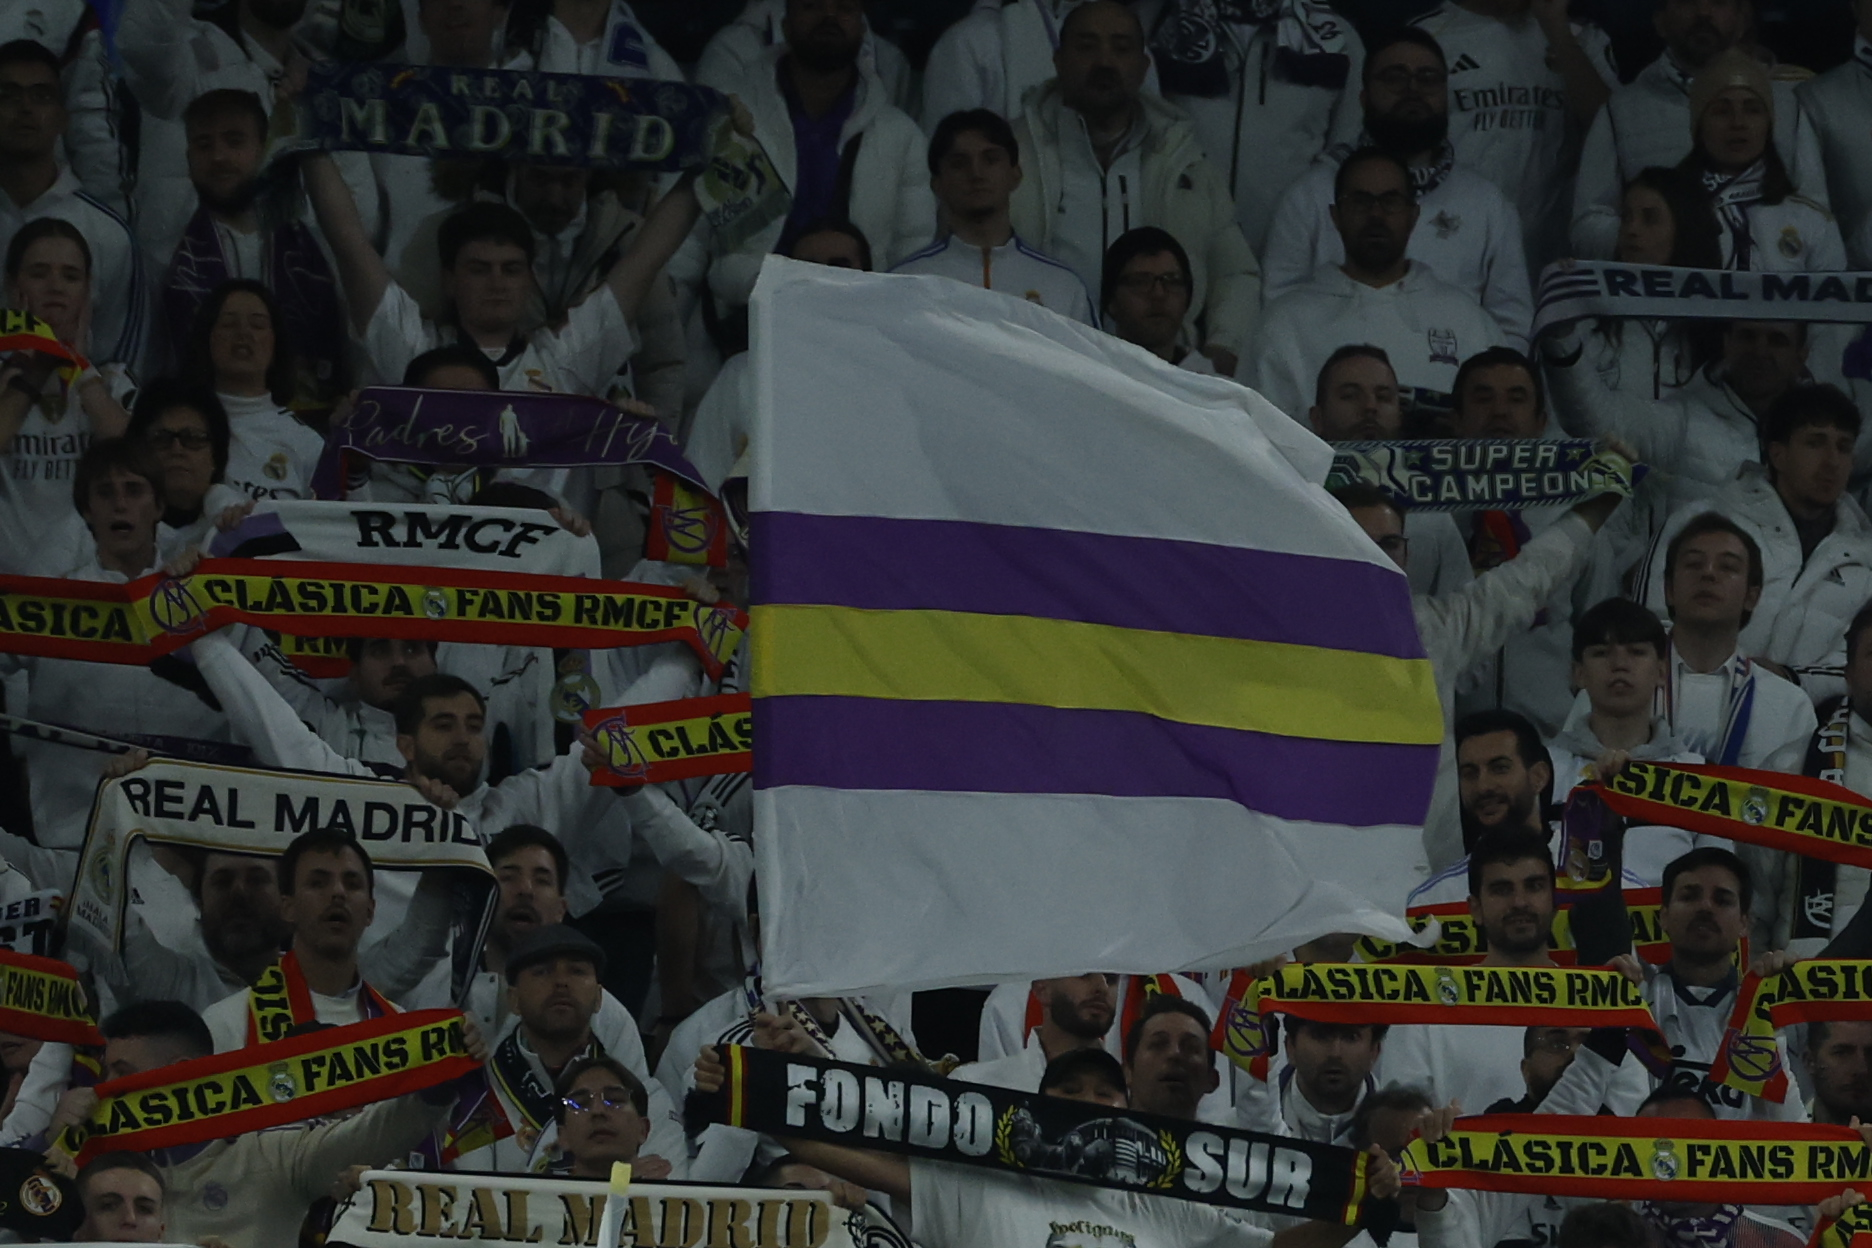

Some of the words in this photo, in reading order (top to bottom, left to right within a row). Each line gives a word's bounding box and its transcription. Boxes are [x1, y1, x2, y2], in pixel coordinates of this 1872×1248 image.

[450, 75, 566, 100] REAL
[1455, 86, 1566, 113] Emirates
[338, 97, 675, 162] MADRID
[1605, 269, 1738, 299] REAL
[345, 395, 490, 455] Padres
[1431, 443, 1558, 471] SUPER
[350, 510, 561, 559] RMCF
[0, 600, 134, 643] ASICA
[455, 588, 562, 625] FANS
[573, 592, 690, 631] RMCF
[653, 712, 752, 761] CLÁS
[1608, 760, 1731, 817] SICA
[119, 777, 256, 830] REAL
[273, 793, 485, 850] MADRID
[3, 968, 46, 1006] FANS
[1464, 971, 1556, 1006] FANS
[302, 1037, 409, 1092] FANS
[786, 1061, 996, 1157] FONDO
[1182, 1130, 1316, 1210] SUR
[1427, 1129, 1641, 1177] CLÁSICA
[1687, 1143, 1795, 1179] FANS
[367, 1177, 544, 1246] REAL
